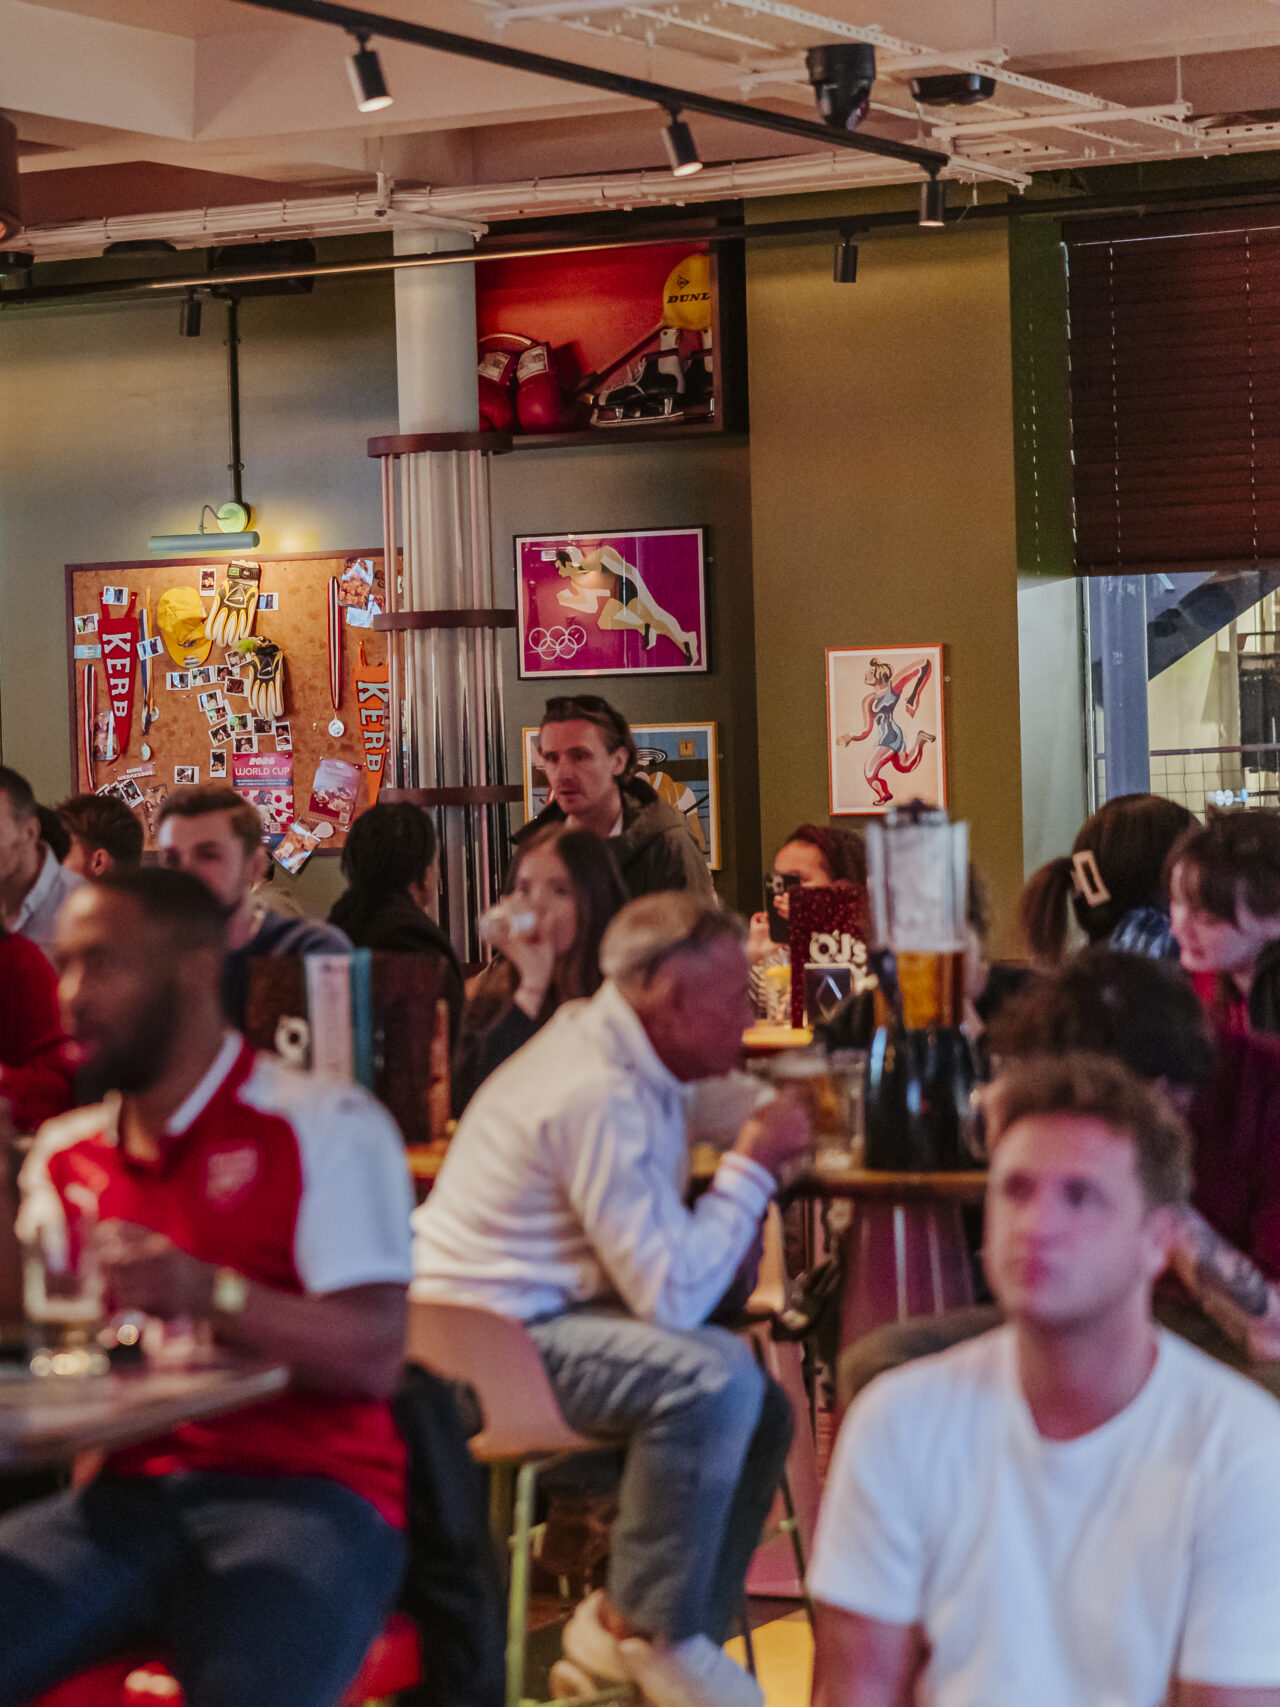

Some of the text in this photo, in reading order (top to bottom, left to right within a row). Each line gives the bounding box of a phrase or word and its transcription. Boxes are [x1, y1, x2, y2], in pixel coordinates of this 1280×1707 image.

[102, 632, 131, 717] KERB
[357, 681, 389, 772] KERB
[235, 767, 290, 776] WORLD CUP
